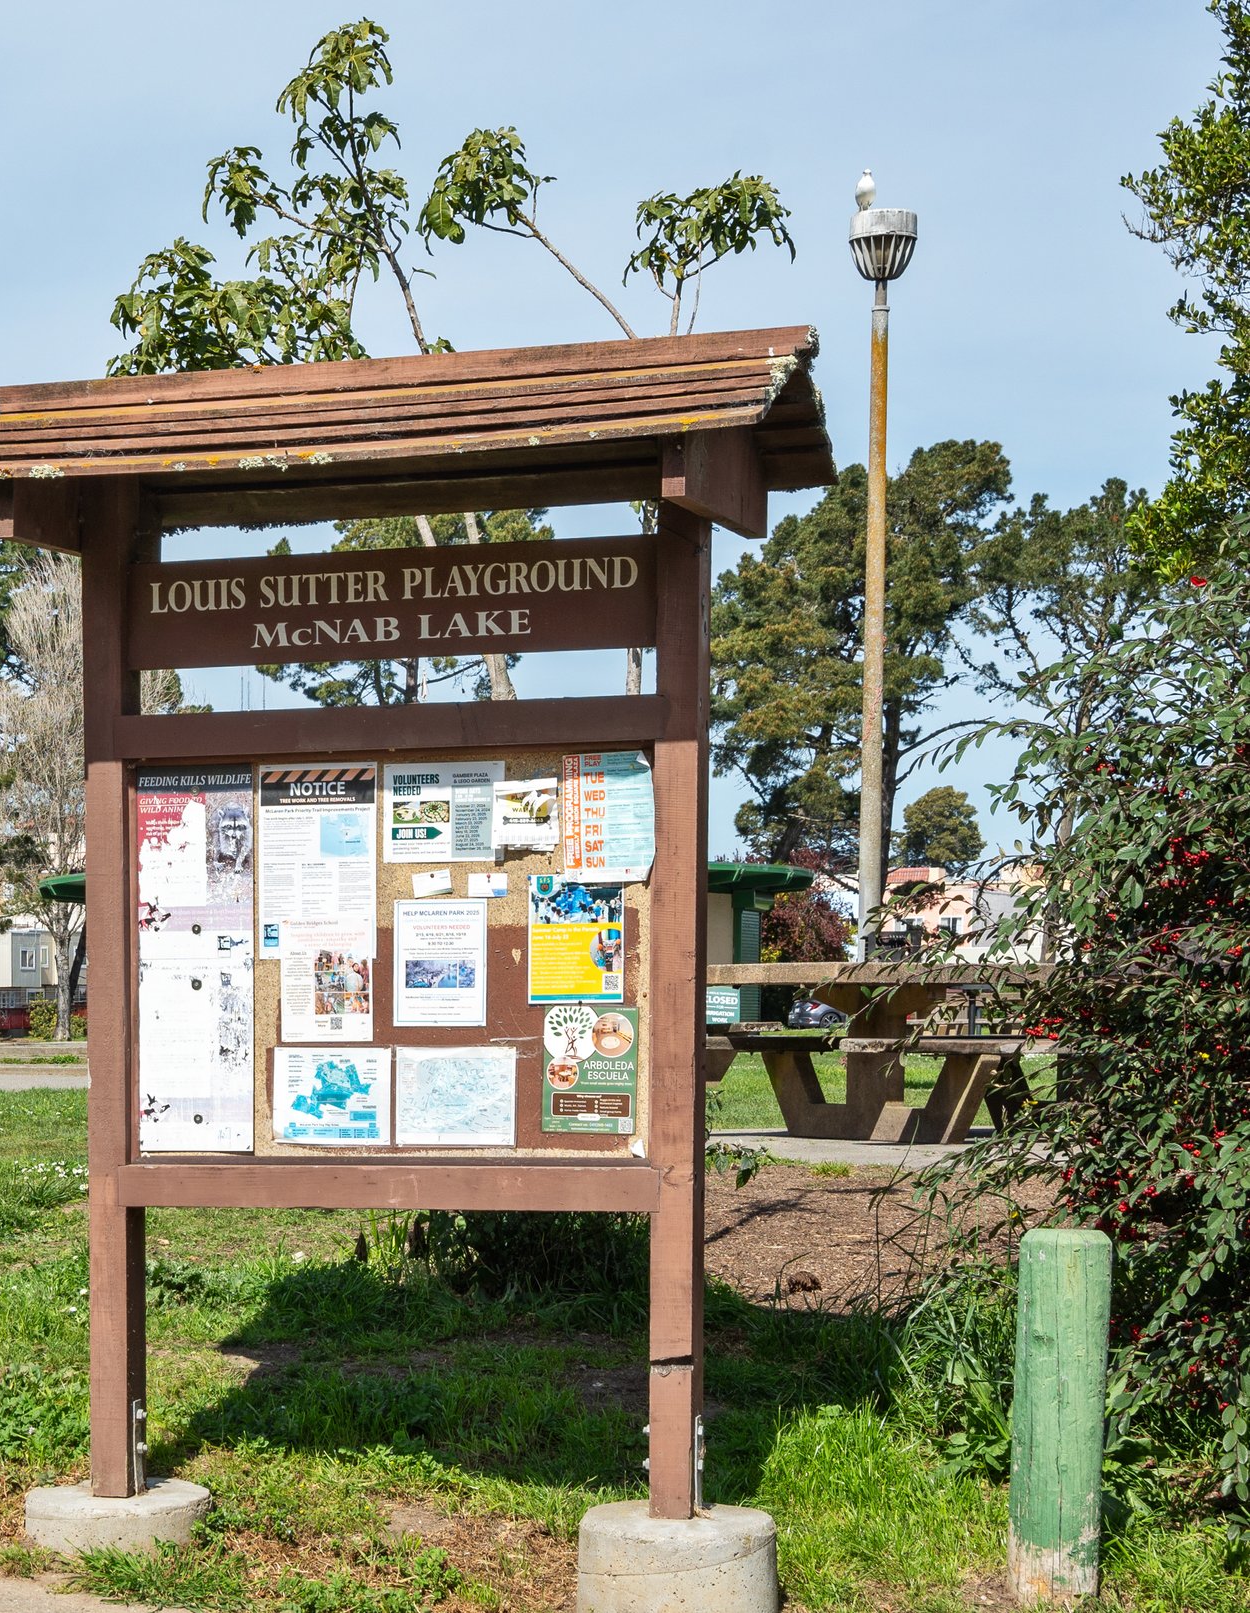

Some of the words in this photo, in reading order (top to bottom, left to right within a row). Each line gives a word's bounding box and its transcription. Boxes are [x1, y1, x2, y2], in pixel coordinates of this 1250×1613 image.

[150, 577, 246, 614] LOUIS
[259, 570, 390, 608] SUTTER
[401, 556, 639, 600] PLAYGROUND
[250, 616, 401, 648] McNAB
[417, 609, 532, 640] LAKE
[139, 776, 178, 786] FEEDING
[180, 775, 206, 786] KILLS
[208, 774, 252, 784] WILDLIFE
[393, 774, 440, 785] VOLUNTEERS
[584, 772, 604, 784] TUE
[290, 782, 346, 796] NOTICE
[393, 786, 421, 796] NEEDED
[140, 797, 167, 805] GIVING
[168, 796, 190, 804] FOOD
[565, 758, 574, 836] PROGRAMMING
[584, 790, 605, 801] WED
[584, 807, 605, 818] THU
[396, 829, 414, 839] JOIN
[415, 828, 427, 838] US!
[585, 825, 602, 836] FRI
[585, 840, 604, 852] SAT
[566, 838, 574, 866] FREE
[586, 857, 605, 868] SUN
[583, 1061, 634, 1070] ARBOLEDA
[588, 1071, 629, 1080] ESCUELA
